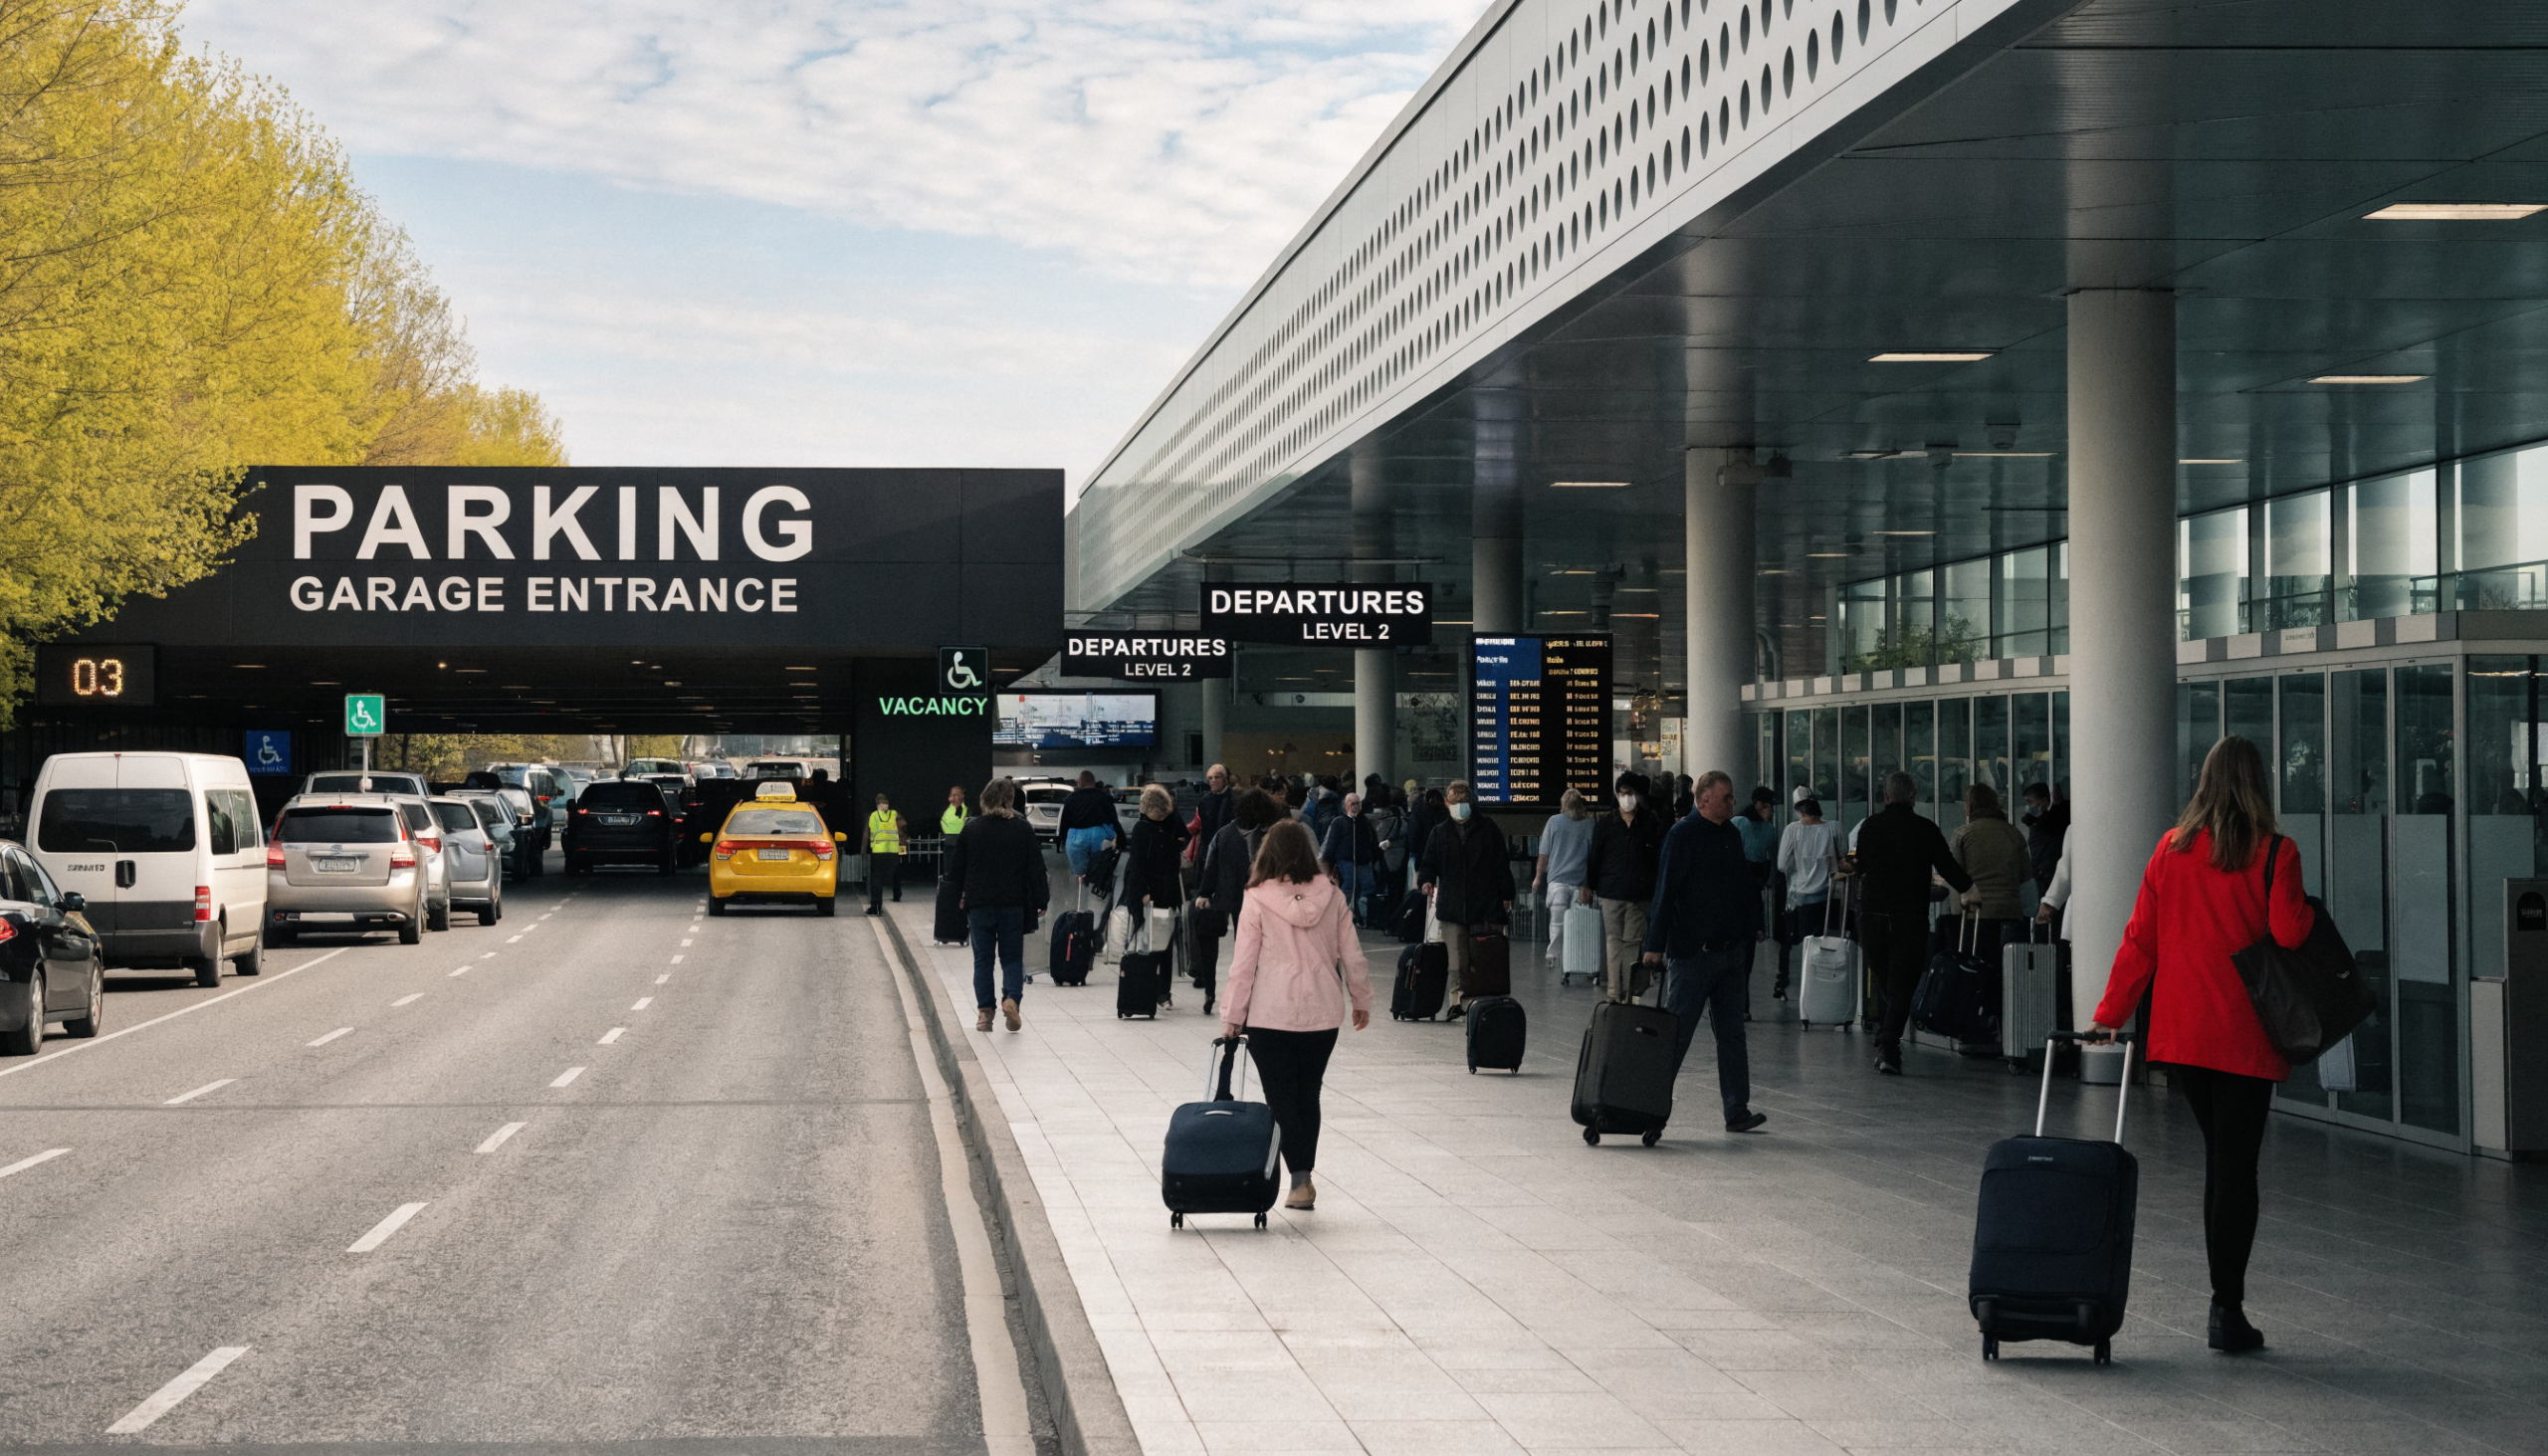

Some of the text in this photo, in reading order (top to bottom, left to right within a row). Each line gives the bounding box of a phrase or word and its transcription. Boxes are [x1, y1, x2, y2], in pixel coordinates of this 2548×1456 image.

[294, 484, 813, 562] PARKING
[290, 575, 798, 613] GARAGE ENTRANCE
[1211, 589, 1424, 615] DEPARTURES
[1303, 623, 1389, 640] LEVEL 2
[1068, 638, 1226, 657] DEPARTURES
[73, 658, 123, 697] 03
[1125, 663, 1191, 677] LEVEL 2
[879, 697, 988, 716] VACANCY
